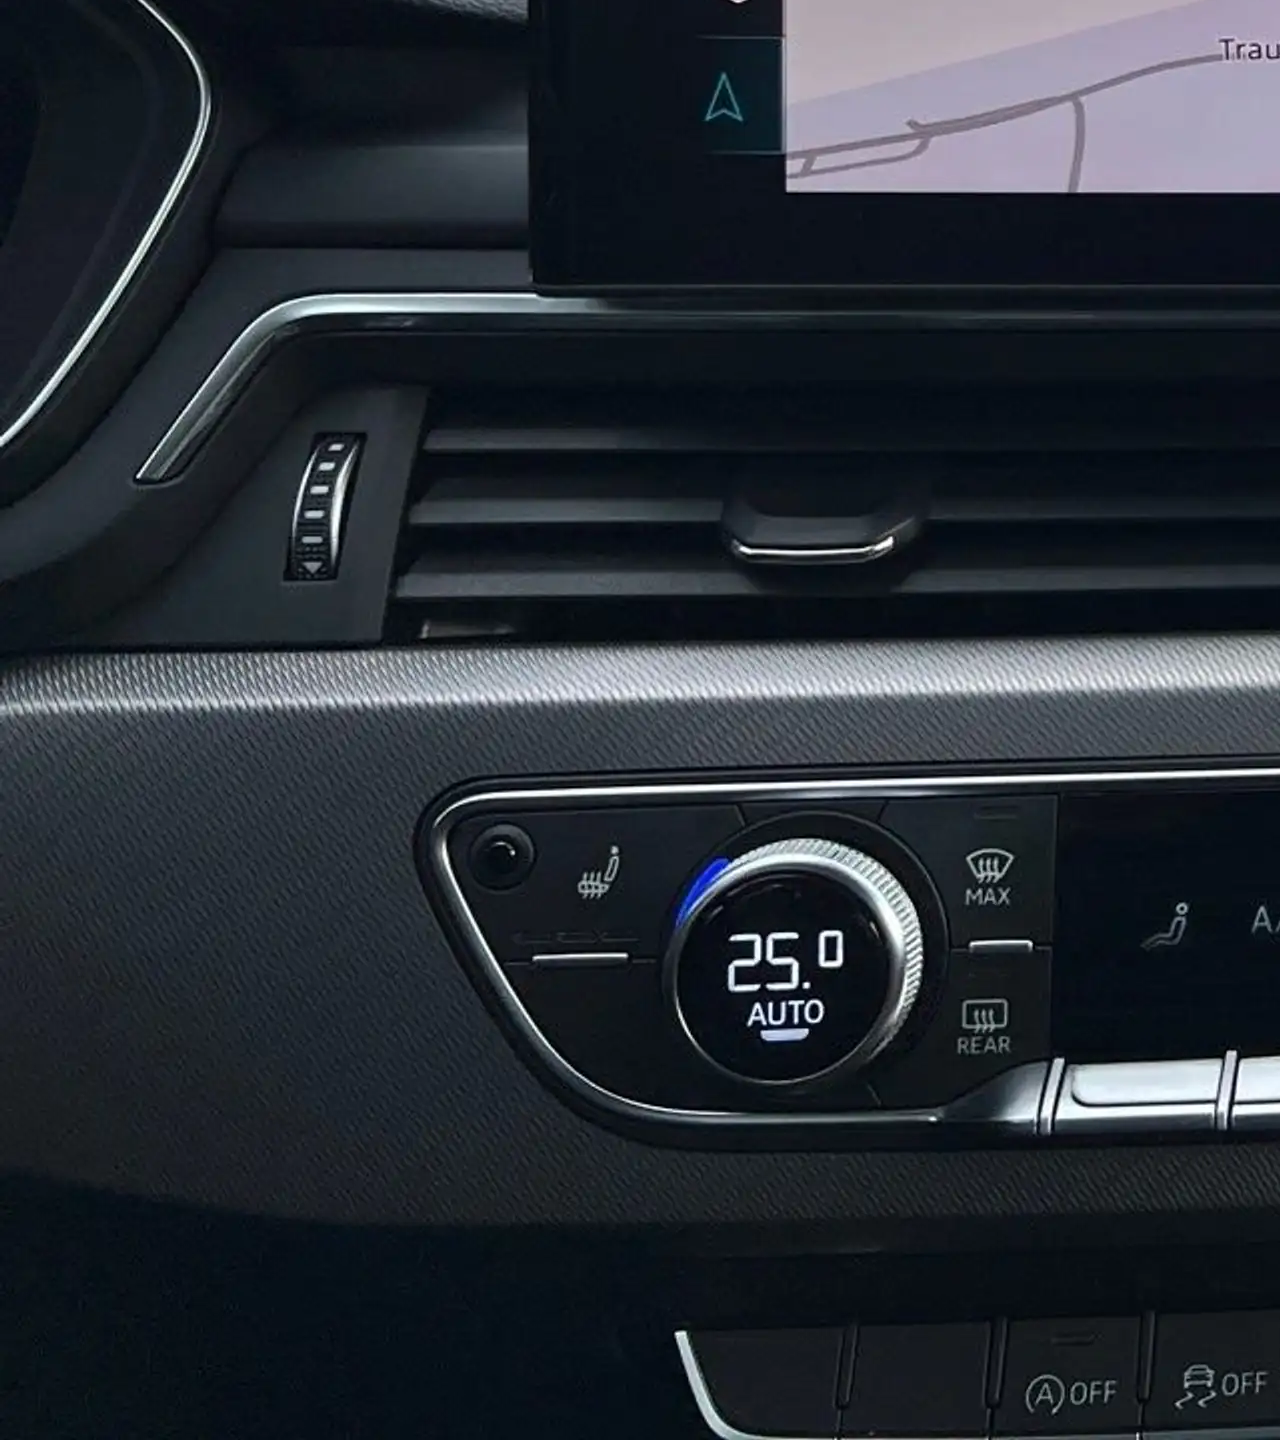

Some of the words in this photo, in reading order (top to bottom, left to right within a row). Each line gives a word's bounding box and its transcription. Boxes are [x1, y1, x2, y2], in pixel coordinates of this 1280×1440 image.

[965, 889, 1011, 905] MAX
[727, 929, 844, 992] 25.0
[746, 1000, 825, 1027] AUTO
[957, 1037, 1011, 1054] REAR
[1070, 1380, 1117, 1406] OFF
[1222, 1372, 1268, 1398] OFF
